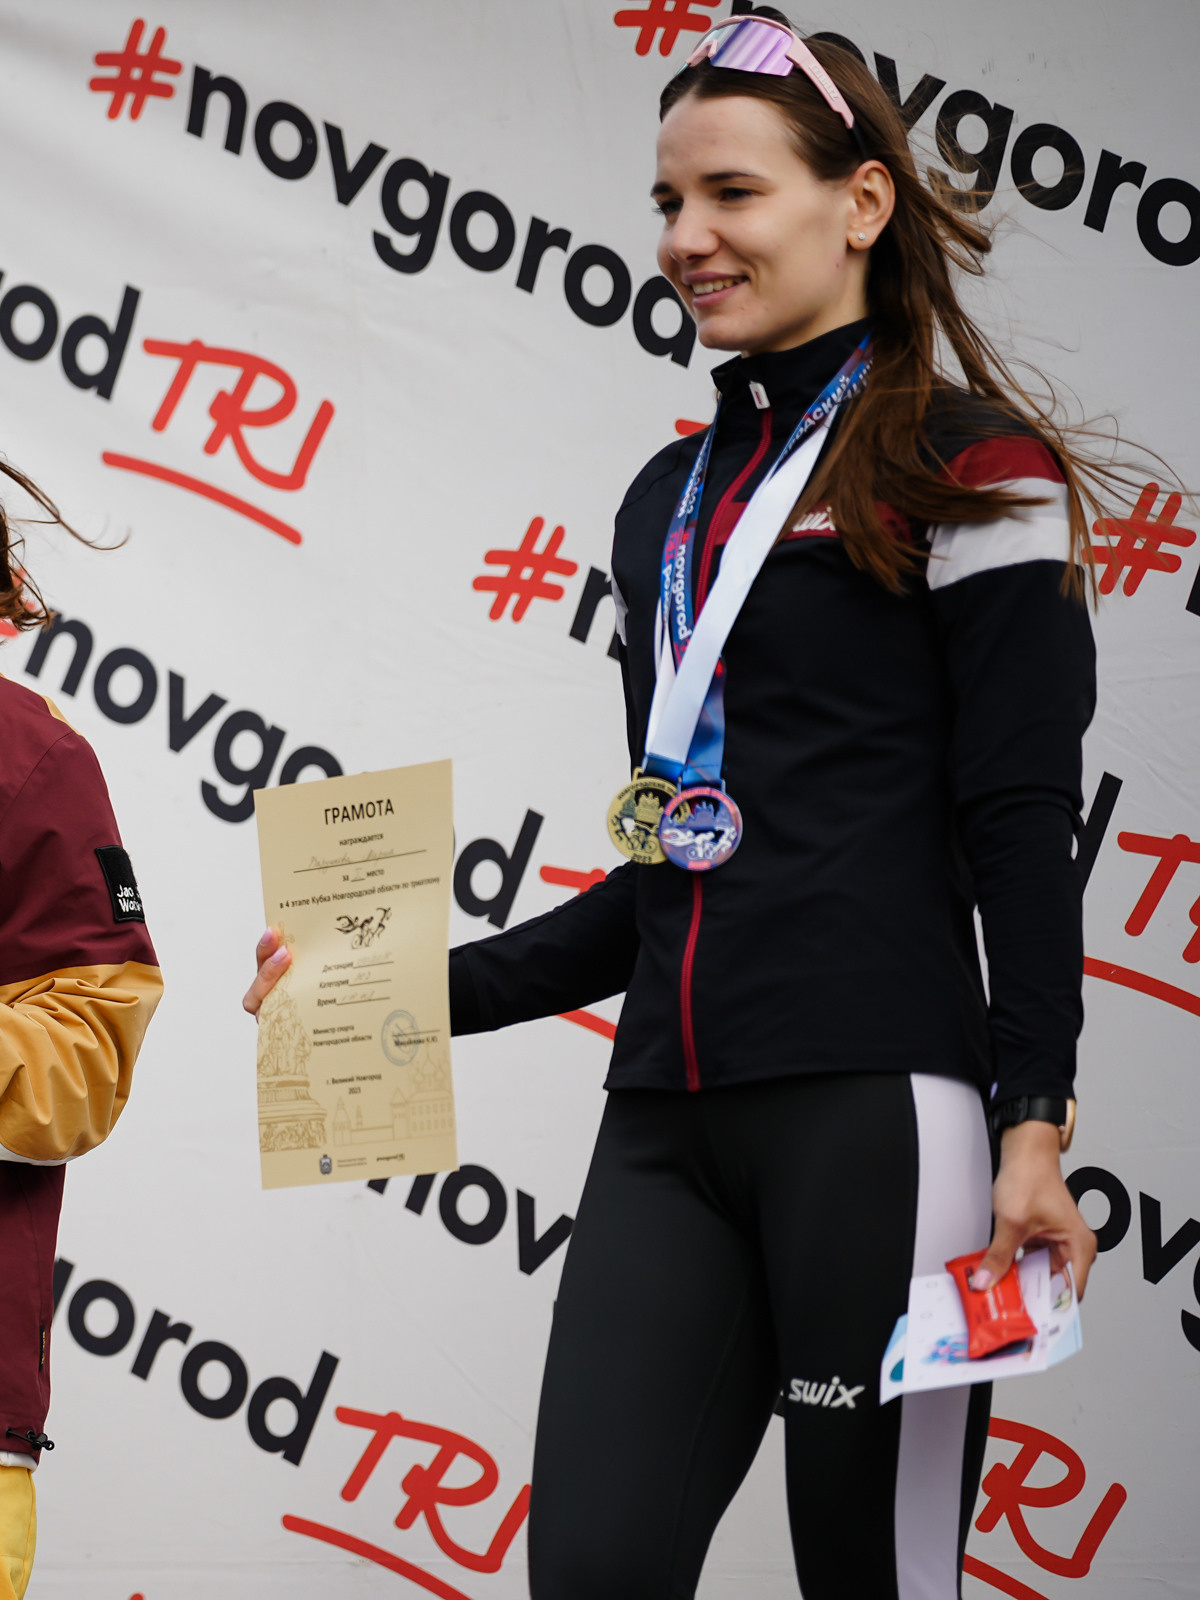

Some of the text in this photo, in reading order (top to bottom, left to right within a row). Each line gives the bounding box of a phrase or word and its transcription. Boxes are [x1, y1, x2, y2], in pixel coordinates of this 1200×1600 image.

[324, 798, 395, 825] ГРАМОТА
[311, 894, 331, 905] Кубка
[789, 1376, 865, 1409] swix
